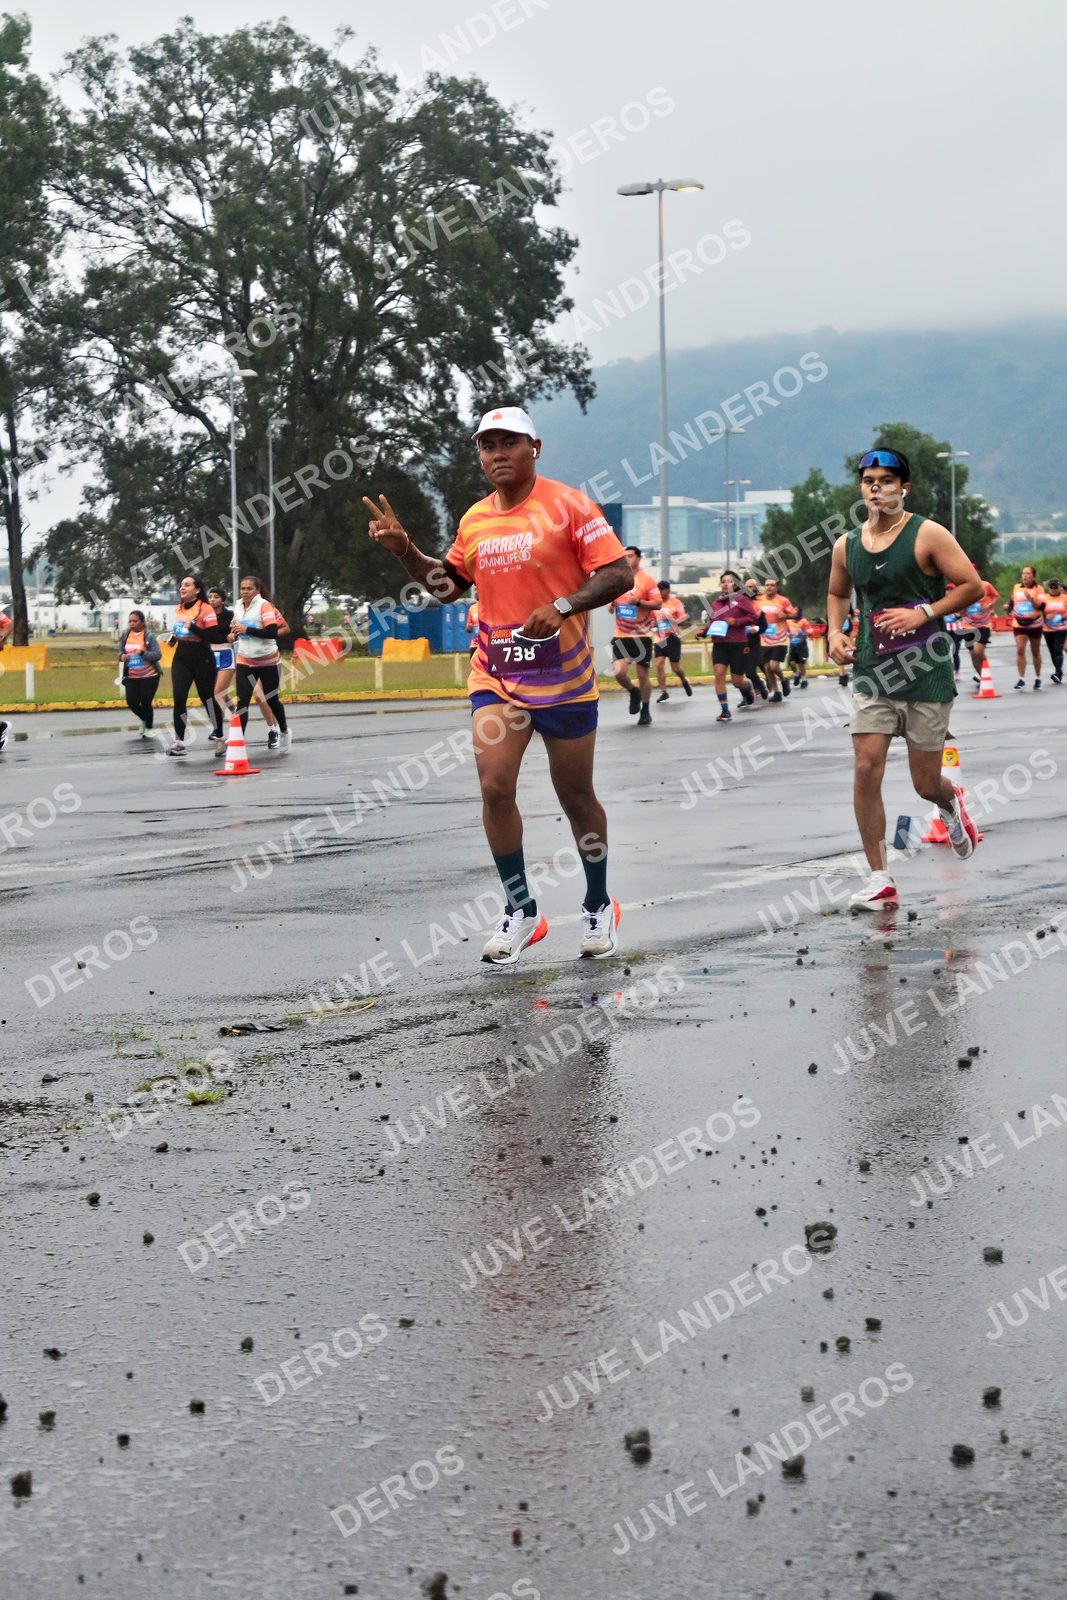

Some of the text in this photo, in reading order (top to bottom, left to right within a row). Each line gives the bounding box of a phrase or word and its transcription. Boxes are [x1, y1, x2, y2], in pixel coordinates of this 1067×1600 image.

[478, 531, 533, 557] CARRERA
[479, 552, 519, 570] OMNILIFE
[502, 646, 536, 663] 738
